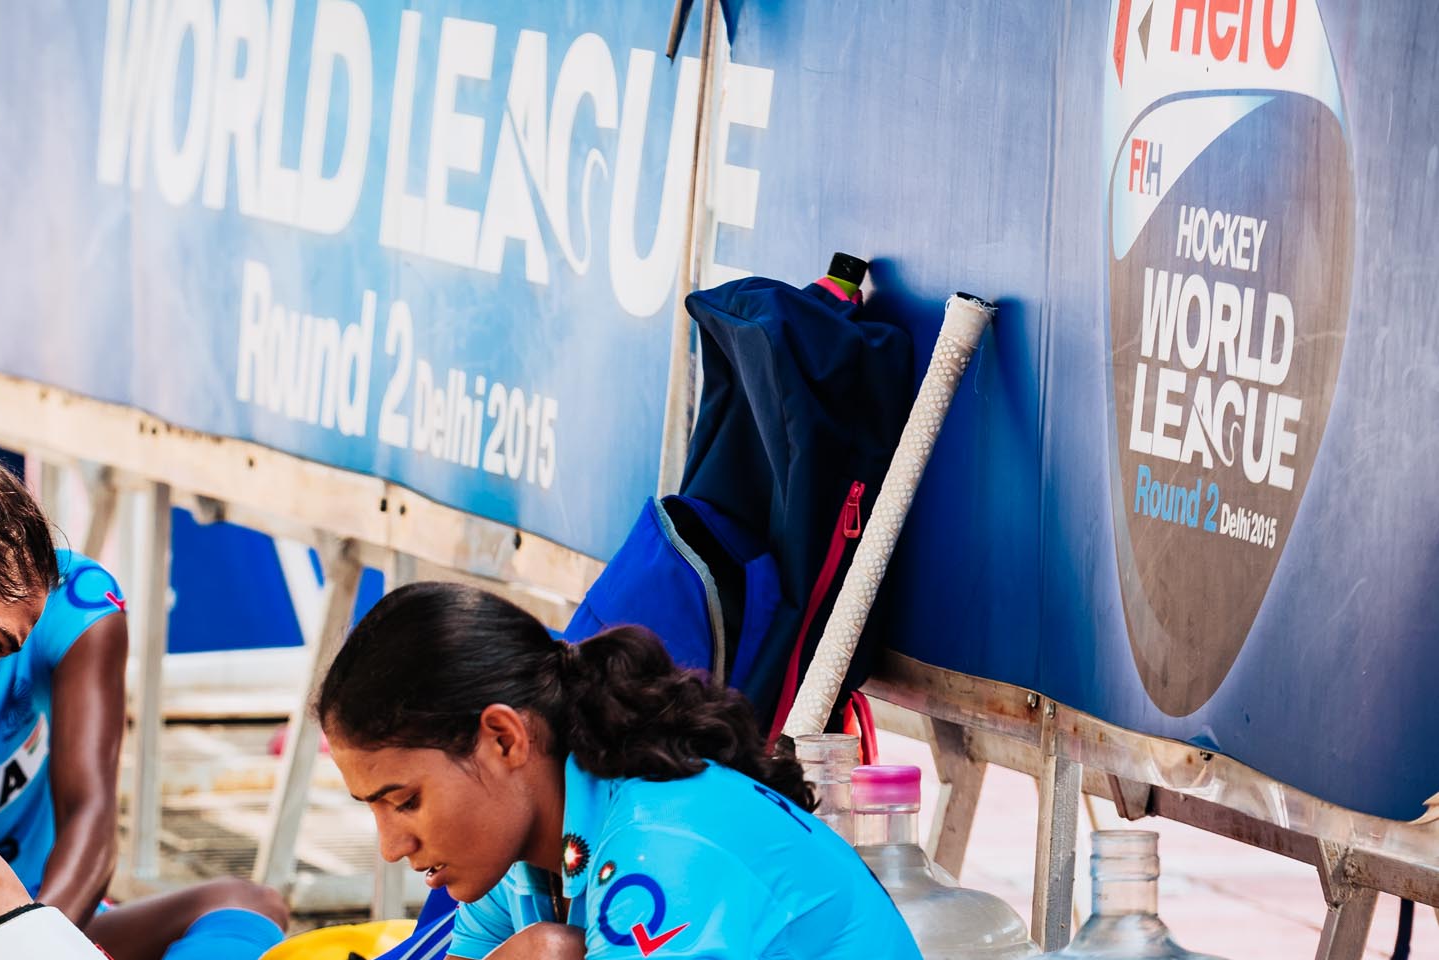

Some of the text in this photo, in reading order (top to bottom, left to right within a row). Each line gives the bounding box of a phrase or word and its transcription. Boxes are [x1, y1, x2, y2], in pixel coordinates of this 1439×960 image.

[96, 0, 373, 235] WORLD
[379, 9, 775, 318] LEAGUE
[1176, 205, 1268, 272] HOCKEY
[236, 260, 558, 490] Round 2 Delhi 2015
[1140, 267, 1295, 386] WORLD
[1129, 362, 1303, 491] LEAGUE
[1134, 464, 1278, 549] Round 2 Delhi 2015
